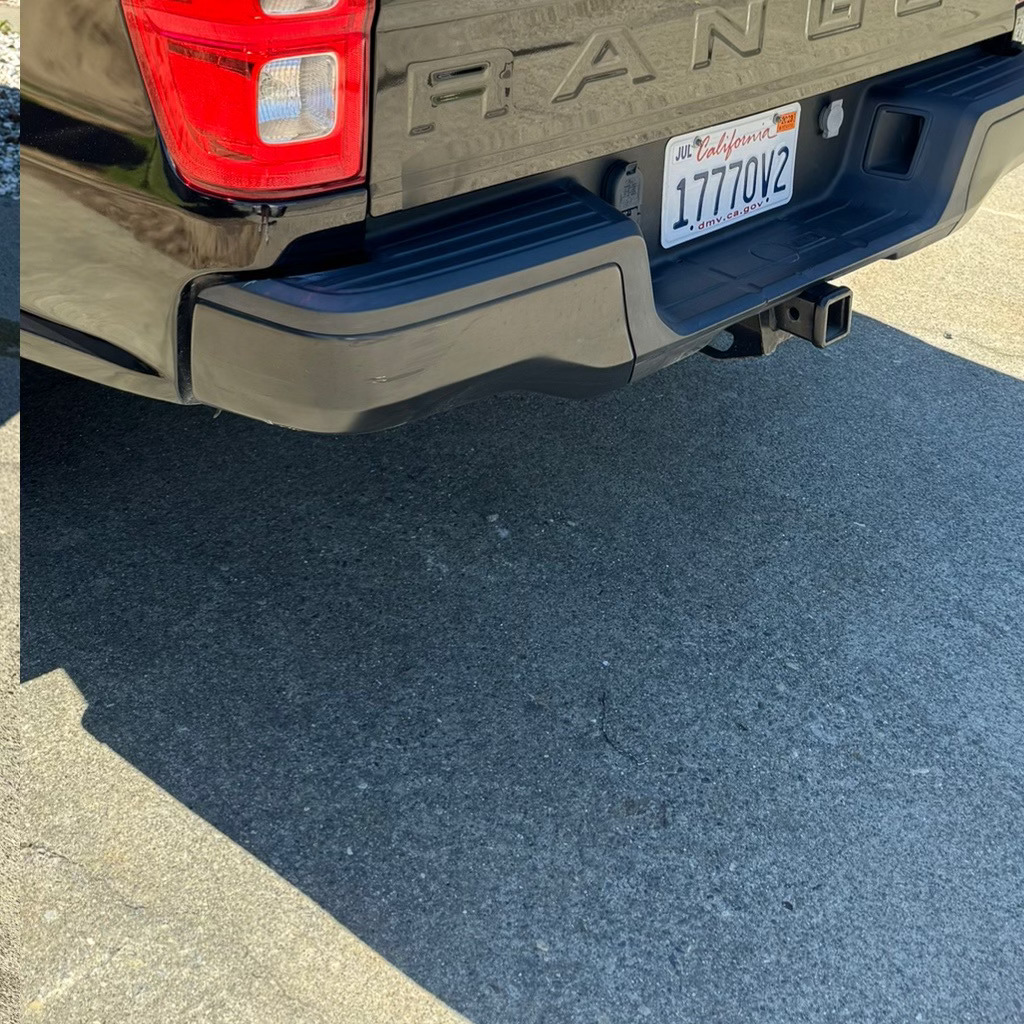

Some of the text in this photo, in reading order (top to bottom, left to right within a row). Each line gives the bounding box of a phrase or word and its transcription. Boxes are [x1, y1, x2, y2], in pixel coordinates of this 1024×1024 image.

[675, 122, 777, 162] JUL California
[672, 145, 790, 230] 17770V2
[697, 200, 764, 230] dmv.ca.gov
